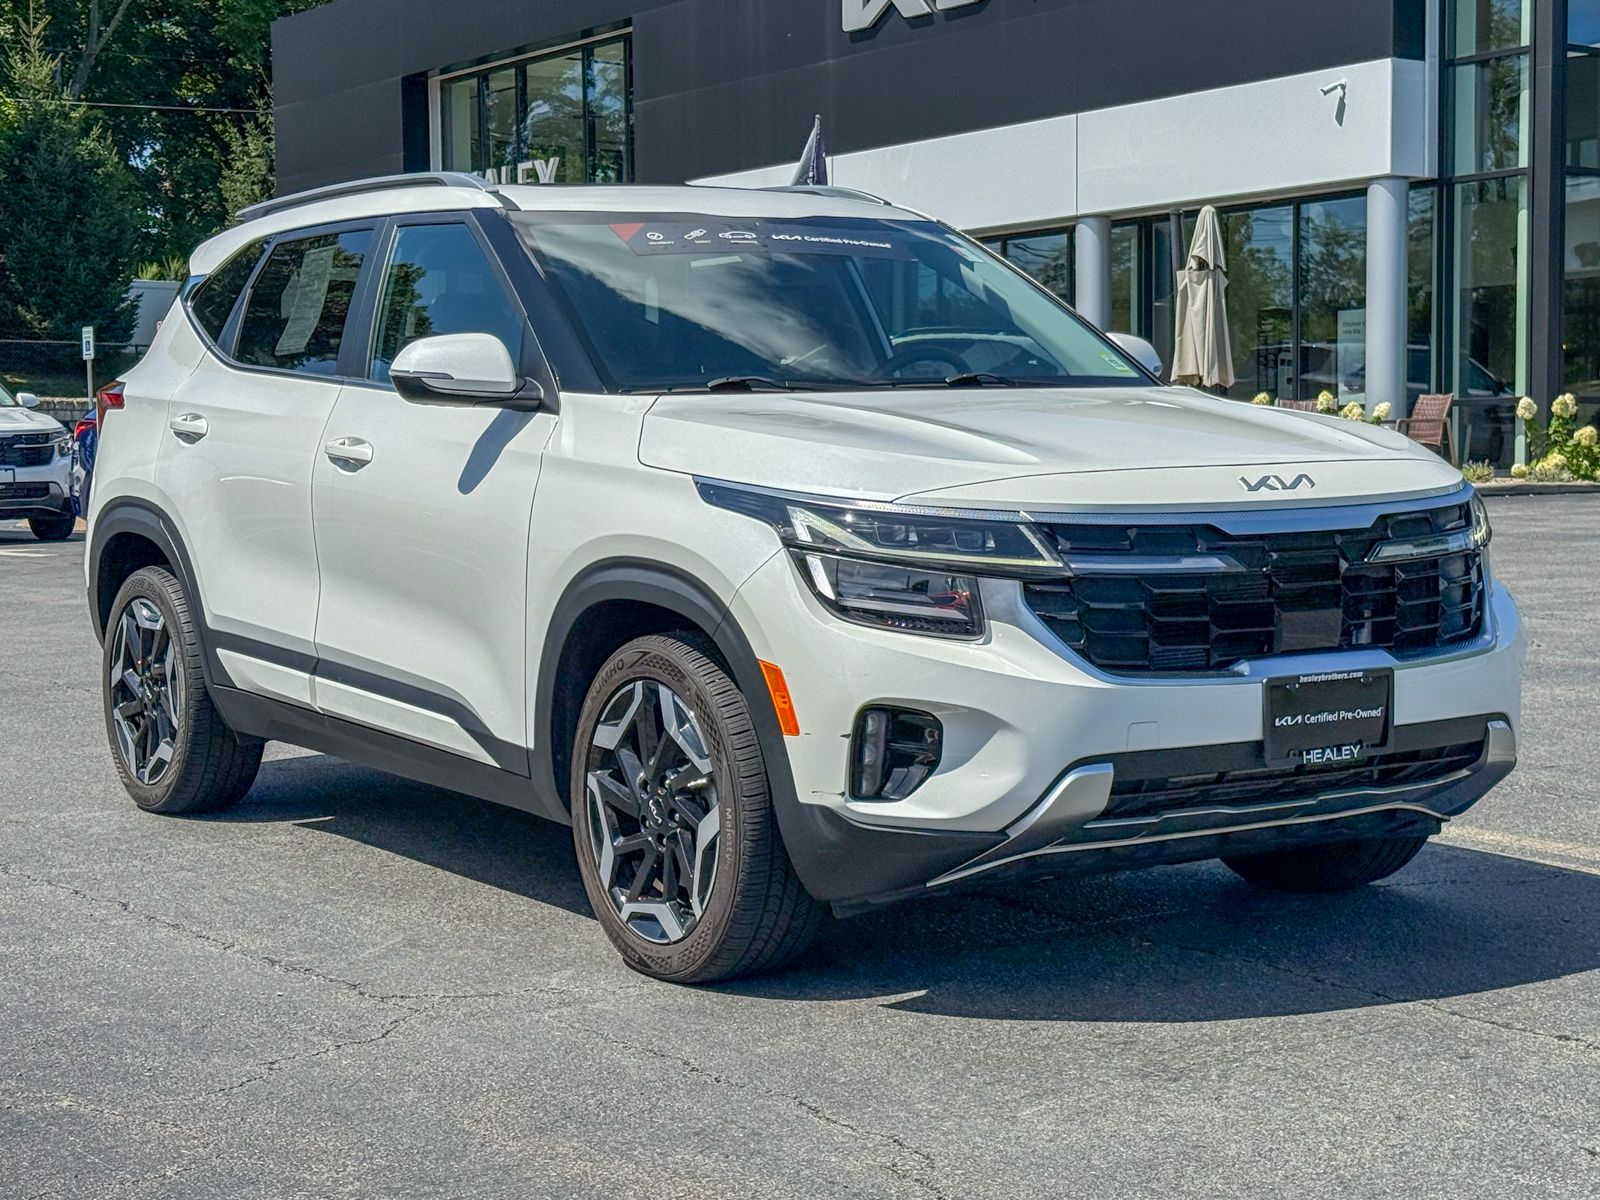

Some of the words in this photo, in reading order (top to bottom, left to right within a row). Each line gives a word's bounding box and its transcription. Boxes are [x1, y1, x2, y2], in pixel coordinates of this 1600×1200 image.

[1238, 473, 1316, 492] KIA
[1299, 671, 1364, 684] healeybrothers.com
[1274, 714, 1303, 727] KIA
[1304, 710, 1338, 725] Certified
[1339, 707, 1382, 720] Pre-Owned
[1302, 744, 1361, 764] HEALEY
